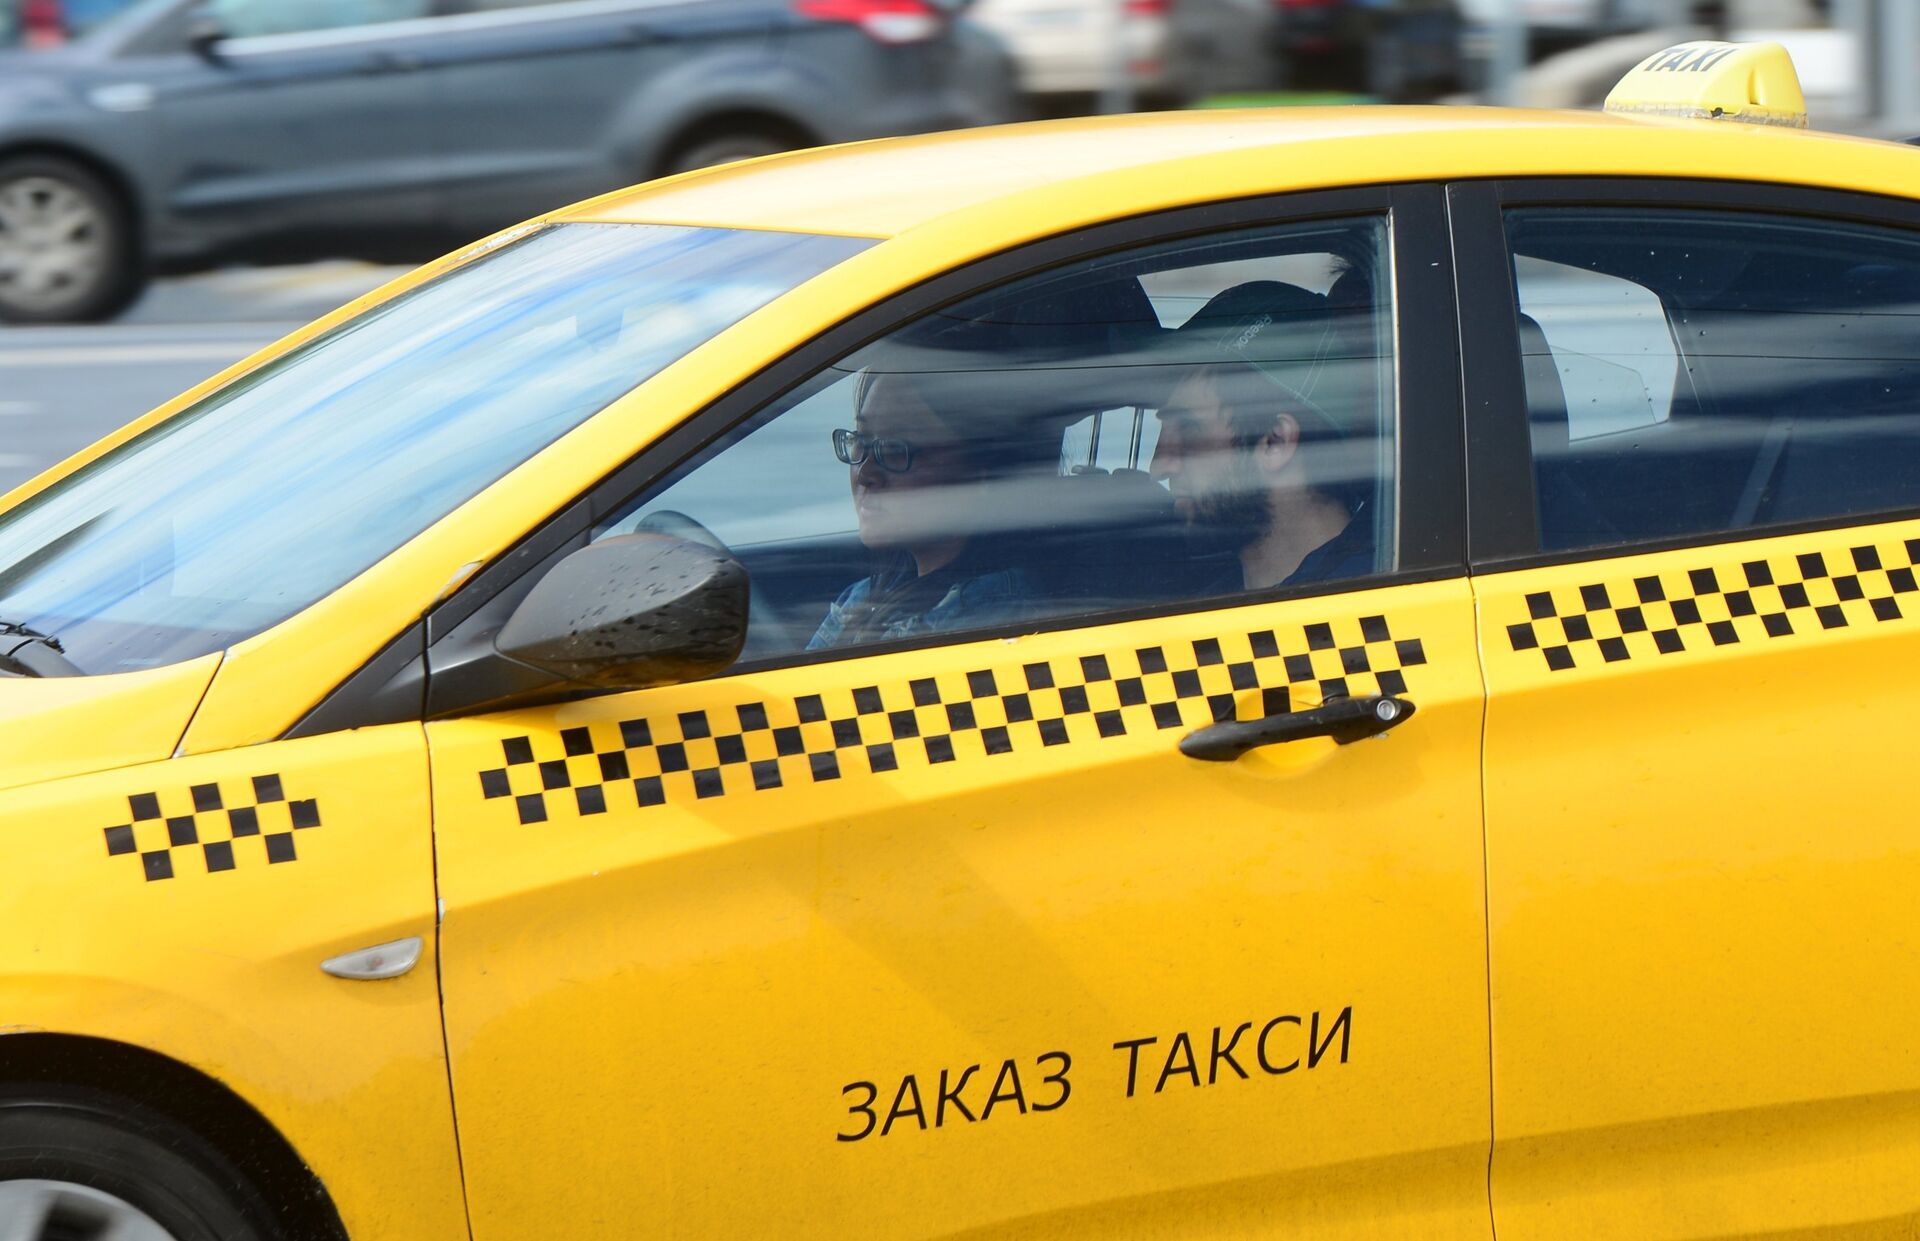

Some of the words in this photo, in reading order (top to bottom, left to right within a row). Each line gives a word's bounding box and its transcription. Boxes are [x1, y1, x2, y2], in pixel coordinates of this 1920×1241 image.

[1644, 48, 1737, 72] TAXI
[1233, 314, 1272, 351] Reebok
[836, 1051, 1072, 1142] ЗАКАЗ
[1113, 1006, 1352, 1097] ТАКСИ
